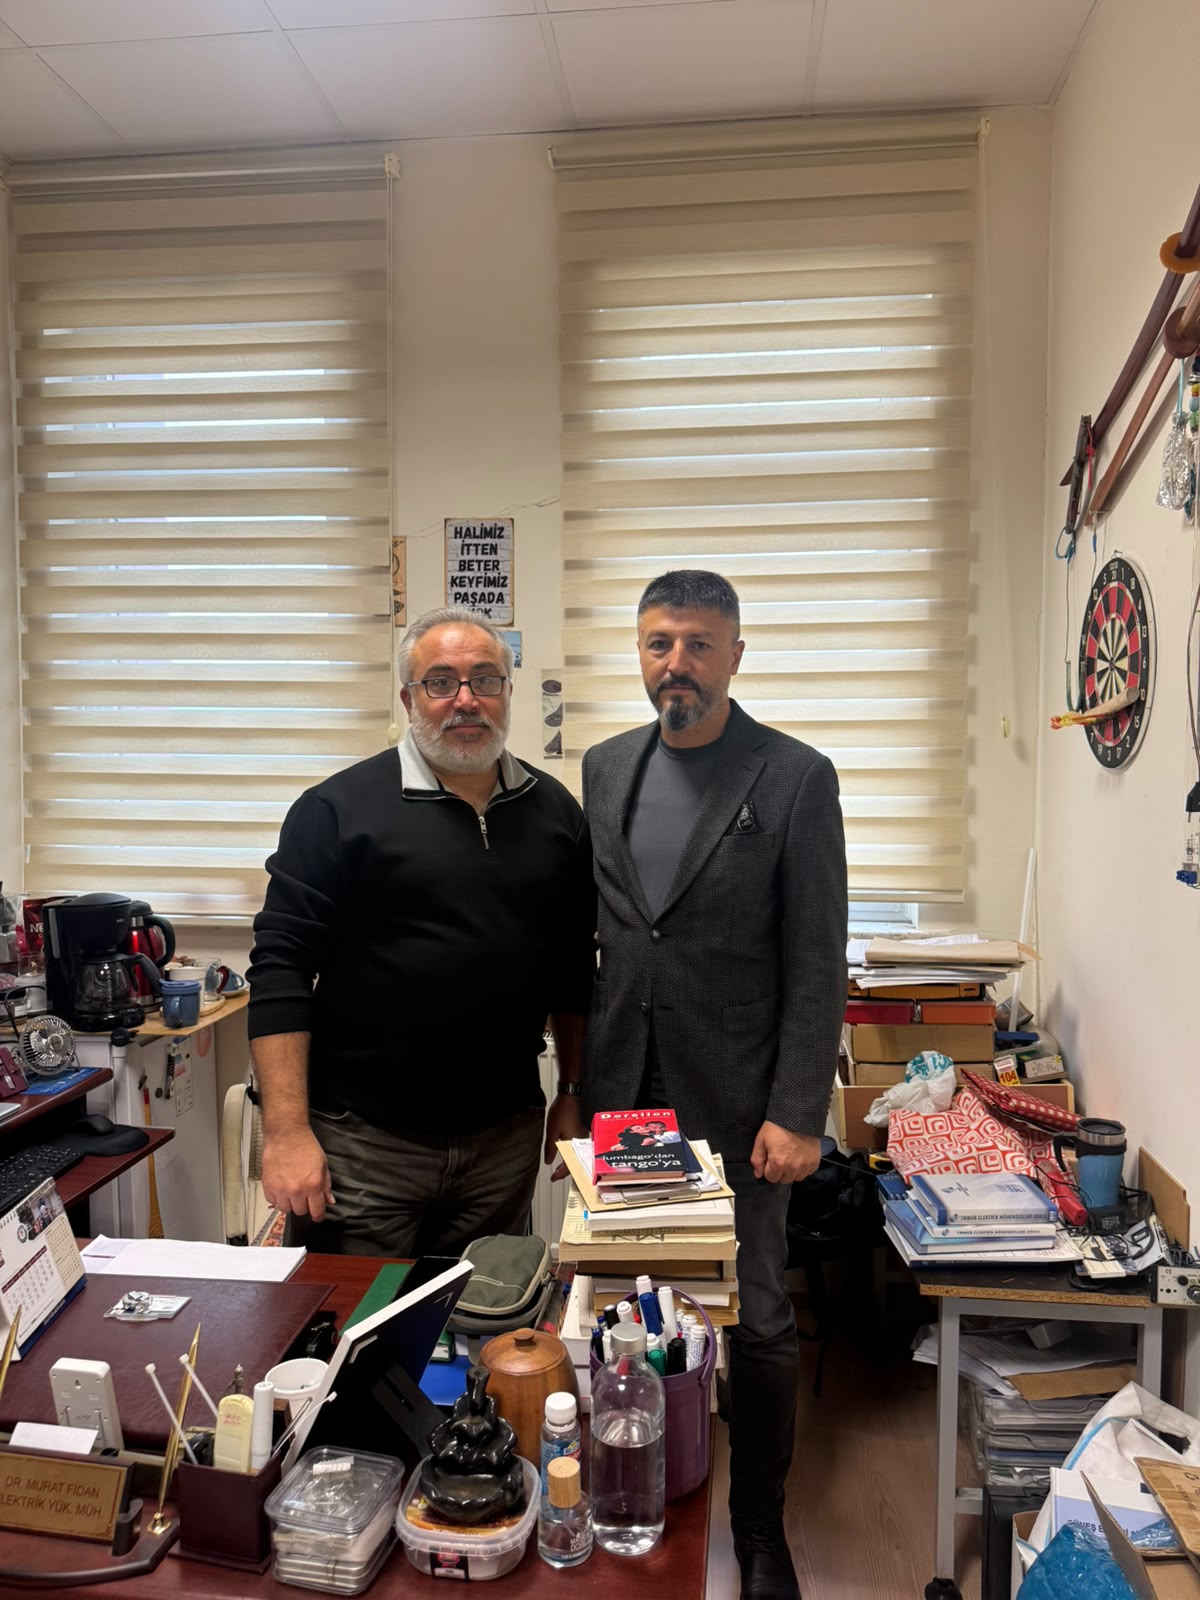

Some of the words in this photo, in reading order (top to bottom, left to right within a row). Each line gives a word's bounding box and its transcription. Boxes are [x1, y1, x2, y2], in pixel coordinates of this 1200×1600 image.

[454, 523, 505, 539] HALİMİZ
[460, 540, 498, 555] İTTEN
[458, 560, 500, 572] BETER
[450, 572, 509, 588] KEYFİMİZ
[454, 592, 505, 607] PAŞADA
[1000, 1070, 1018, 1084] 104
[603, 1153, 675, 1161] lumbago'dan
[611, 1159, 682, 1169] tango'ya
[4, 1475, 22, 1489] DR.
[25, 1478, 65, 1494] MURAT
[66, 1482, 101, 1499] FİDAN
[0, 1493, 46, 1511] LEKTRİK
[75, 1503, 104, 1519] MÜH.
